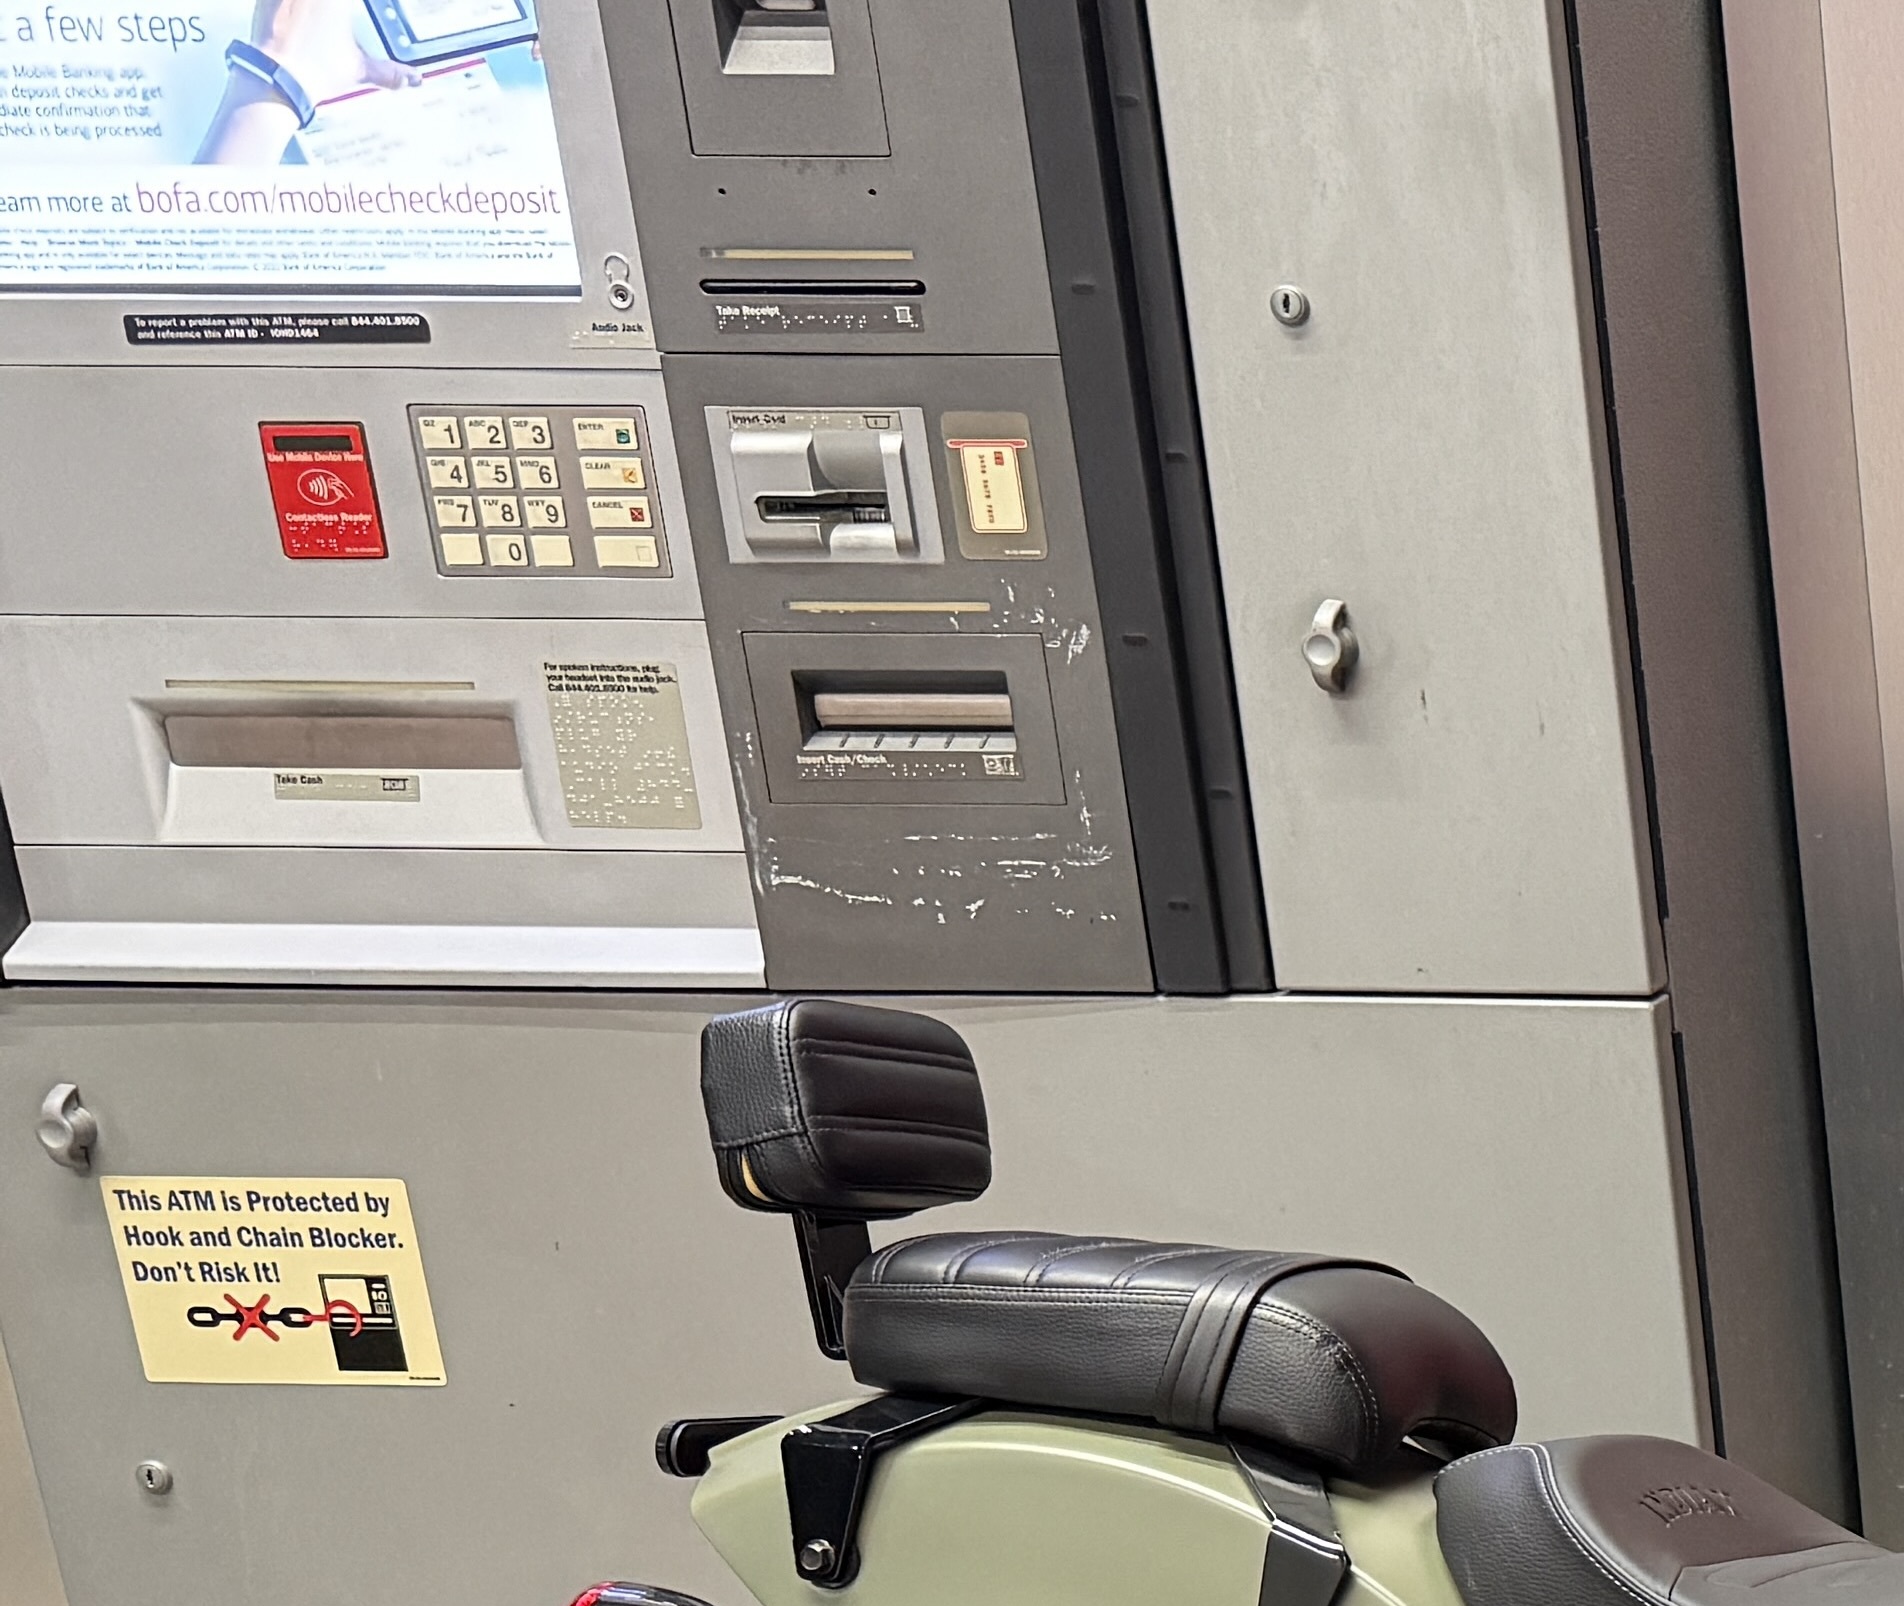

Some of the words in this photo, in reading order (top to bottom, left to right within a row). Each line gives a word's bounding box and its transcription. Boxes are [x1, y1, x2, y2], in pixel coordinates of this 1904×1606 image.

[15, 16, 34, 42] a
[45, 5, 103, 42] few
[117, 13, 206, 52] steps
[12, 64, 57, 80] Mobile
[61, 64, 115, 81] Banking
[11, 85, 60, 100] deposit
[65, 85, 109, 99] checks
[114, 86, 138, 99] and
[142, 86, 164, 101] get
[35, 103, 120, 117] confirmation
[124, 103, 151, 117] that
[40, 124, 50, 137] is
[55, 123, 91, 140] being
[95, 123, 163, 139] processed
[48, 194, 103, 213] more
[111, 193, 133, 213] at
[136, 181, 561, 221] bofa.com/mobilecheckdeposit
[716, 305, 740, 316] Take
[742, 305, 780, 317] Receipt
[134, 316, 147, 327] To
[148, 317, 178, 328] report
[188, 316, 227, 328] problem
[230, 316, 249, 327] with
[251, 316, 270, 327] this
[298, 316, 329, 328] please
[592, 322, 619, 332] Audio
[621, 322, 645, 332] Jack
[137, 328, 155, 339] and
[157, 329, 202, 339] reference
[204, 329, 222, 339] this
[224, 329, 245, 339] ATM
[443, 424, 455, 444] 1
[486, 425, 501, 445] 2
[531, 425, 546, 445] 3
[449, 465, 463, 484] 4
[492, 465, 508, 484] 5
[538, 465, 553, 484] 6
[456, 504, 469, 523] 7
[500, 504, 515, 523] 8
[545, 504, 560, 524] 9
[276, 775, 298, 784] Take
[300, 775, 323, 784] Cash
[112, 1189, 162, 1212] This
[167, 1189, 216, 1212] ATM
[220, 1190, 241, 1212] is
[247, 1190, 360, 1213] Protected
[364, 1191, 390, 1218] by
[123, 1225, 185, 1247] Hook
[189, 1226, 232, 1248] and
[237, 1226, 304, 1248] Chain
[308, 1226, 404, 1249] Blocker.
[132, 1260, 195, 1283] Don't
[198, 1261, 249, 1283] Risk
[253, 1261, 281, 1283] It!
